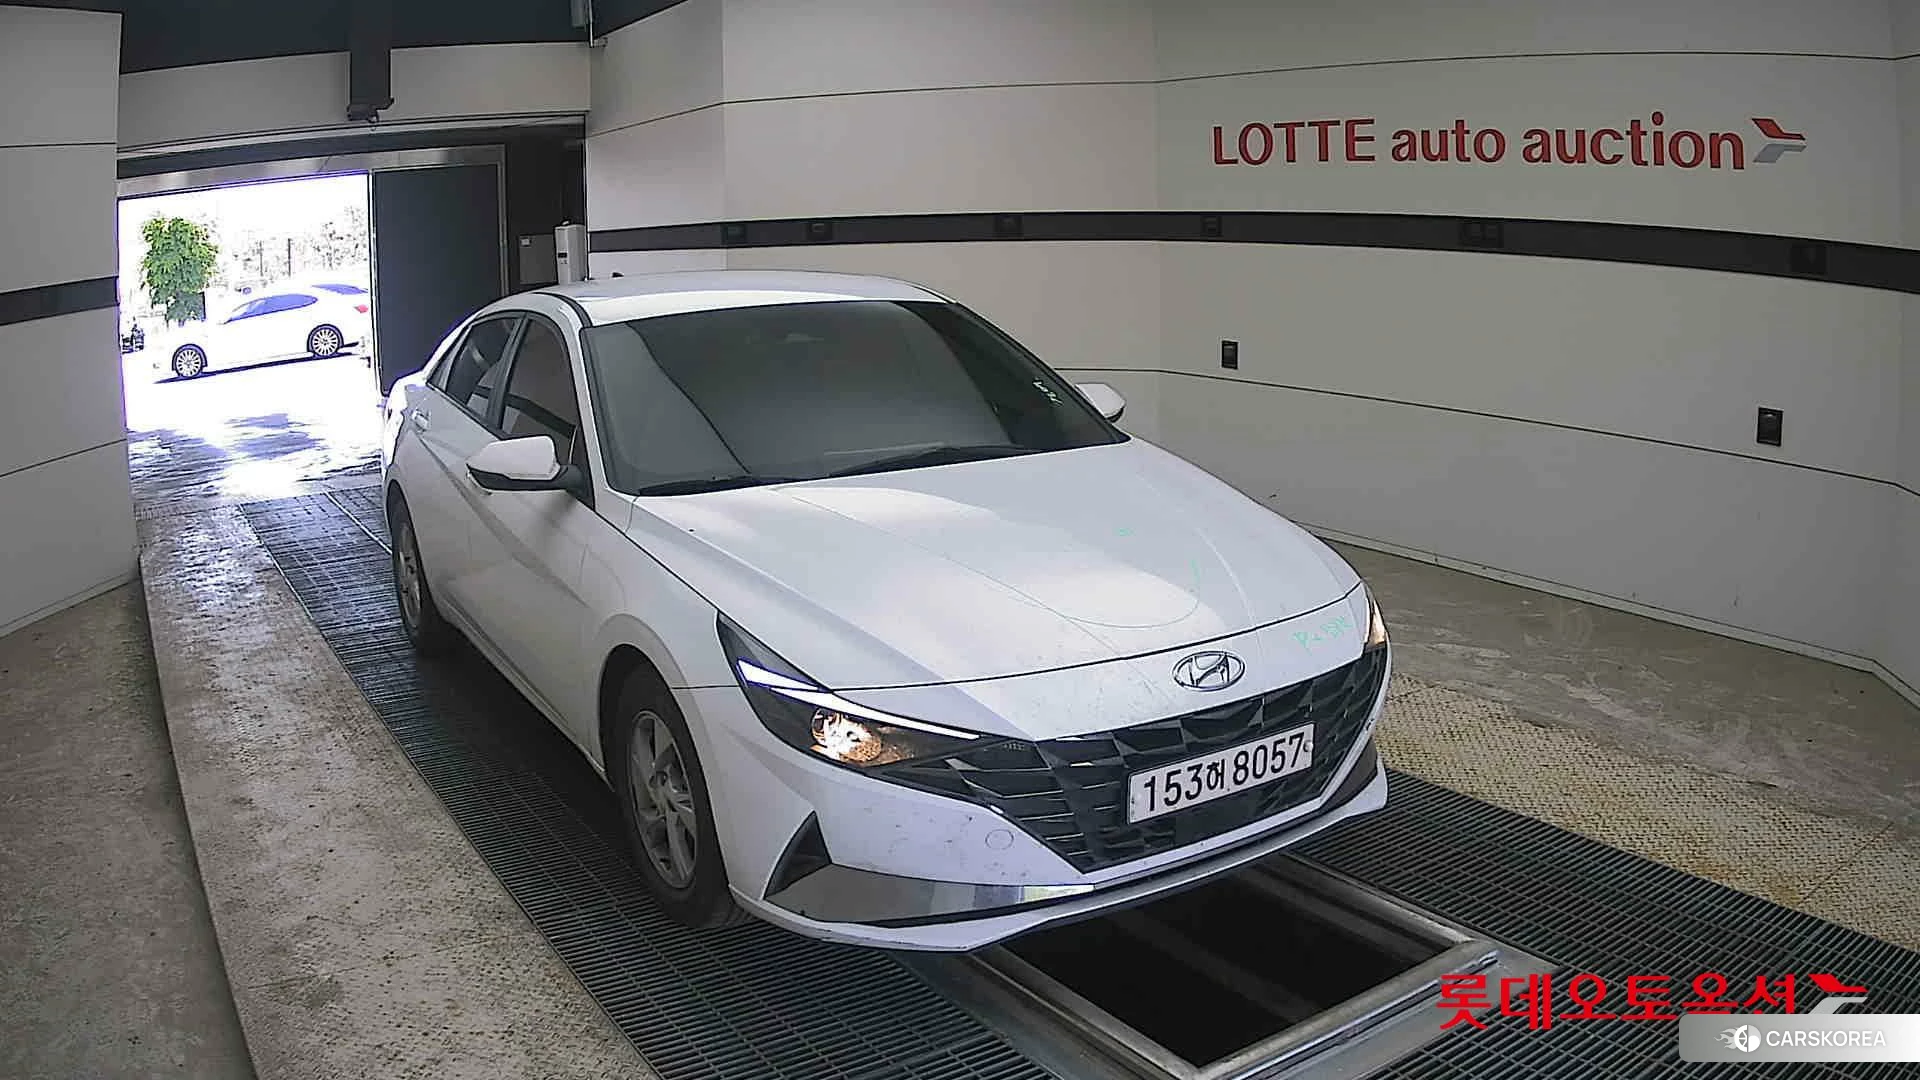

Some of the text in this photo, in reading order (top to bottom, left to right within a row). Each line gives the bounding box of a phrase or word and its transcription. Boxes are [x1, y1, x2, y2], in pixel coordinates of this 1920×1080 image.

[1213, 111, 1745, 170] LOTTE auto auction
